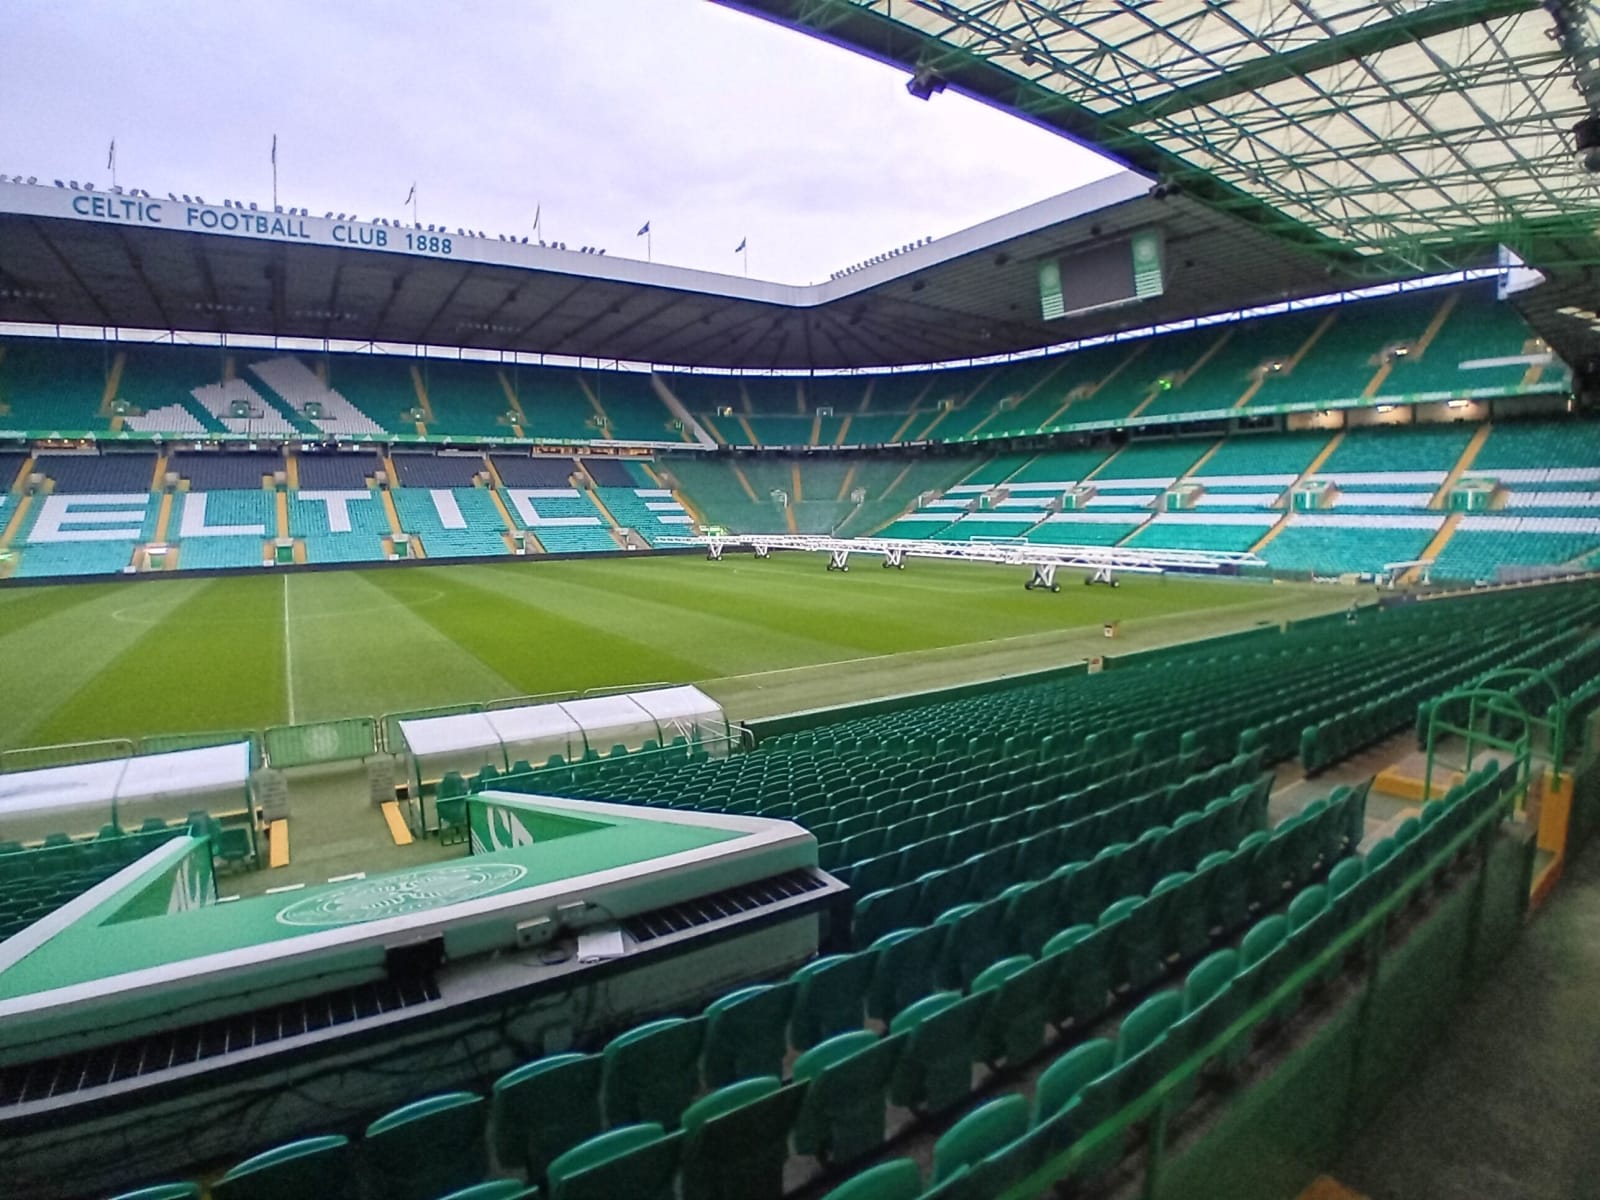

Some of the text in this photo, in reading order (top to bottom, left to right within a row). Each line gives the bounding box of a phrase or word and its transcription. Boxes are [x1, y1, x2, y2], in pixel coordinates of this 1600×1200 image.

[73, 195, 453, 254] CELTIC FOOTBALL CLUB 1888
[0, 488, 602, 543] ELTIC
